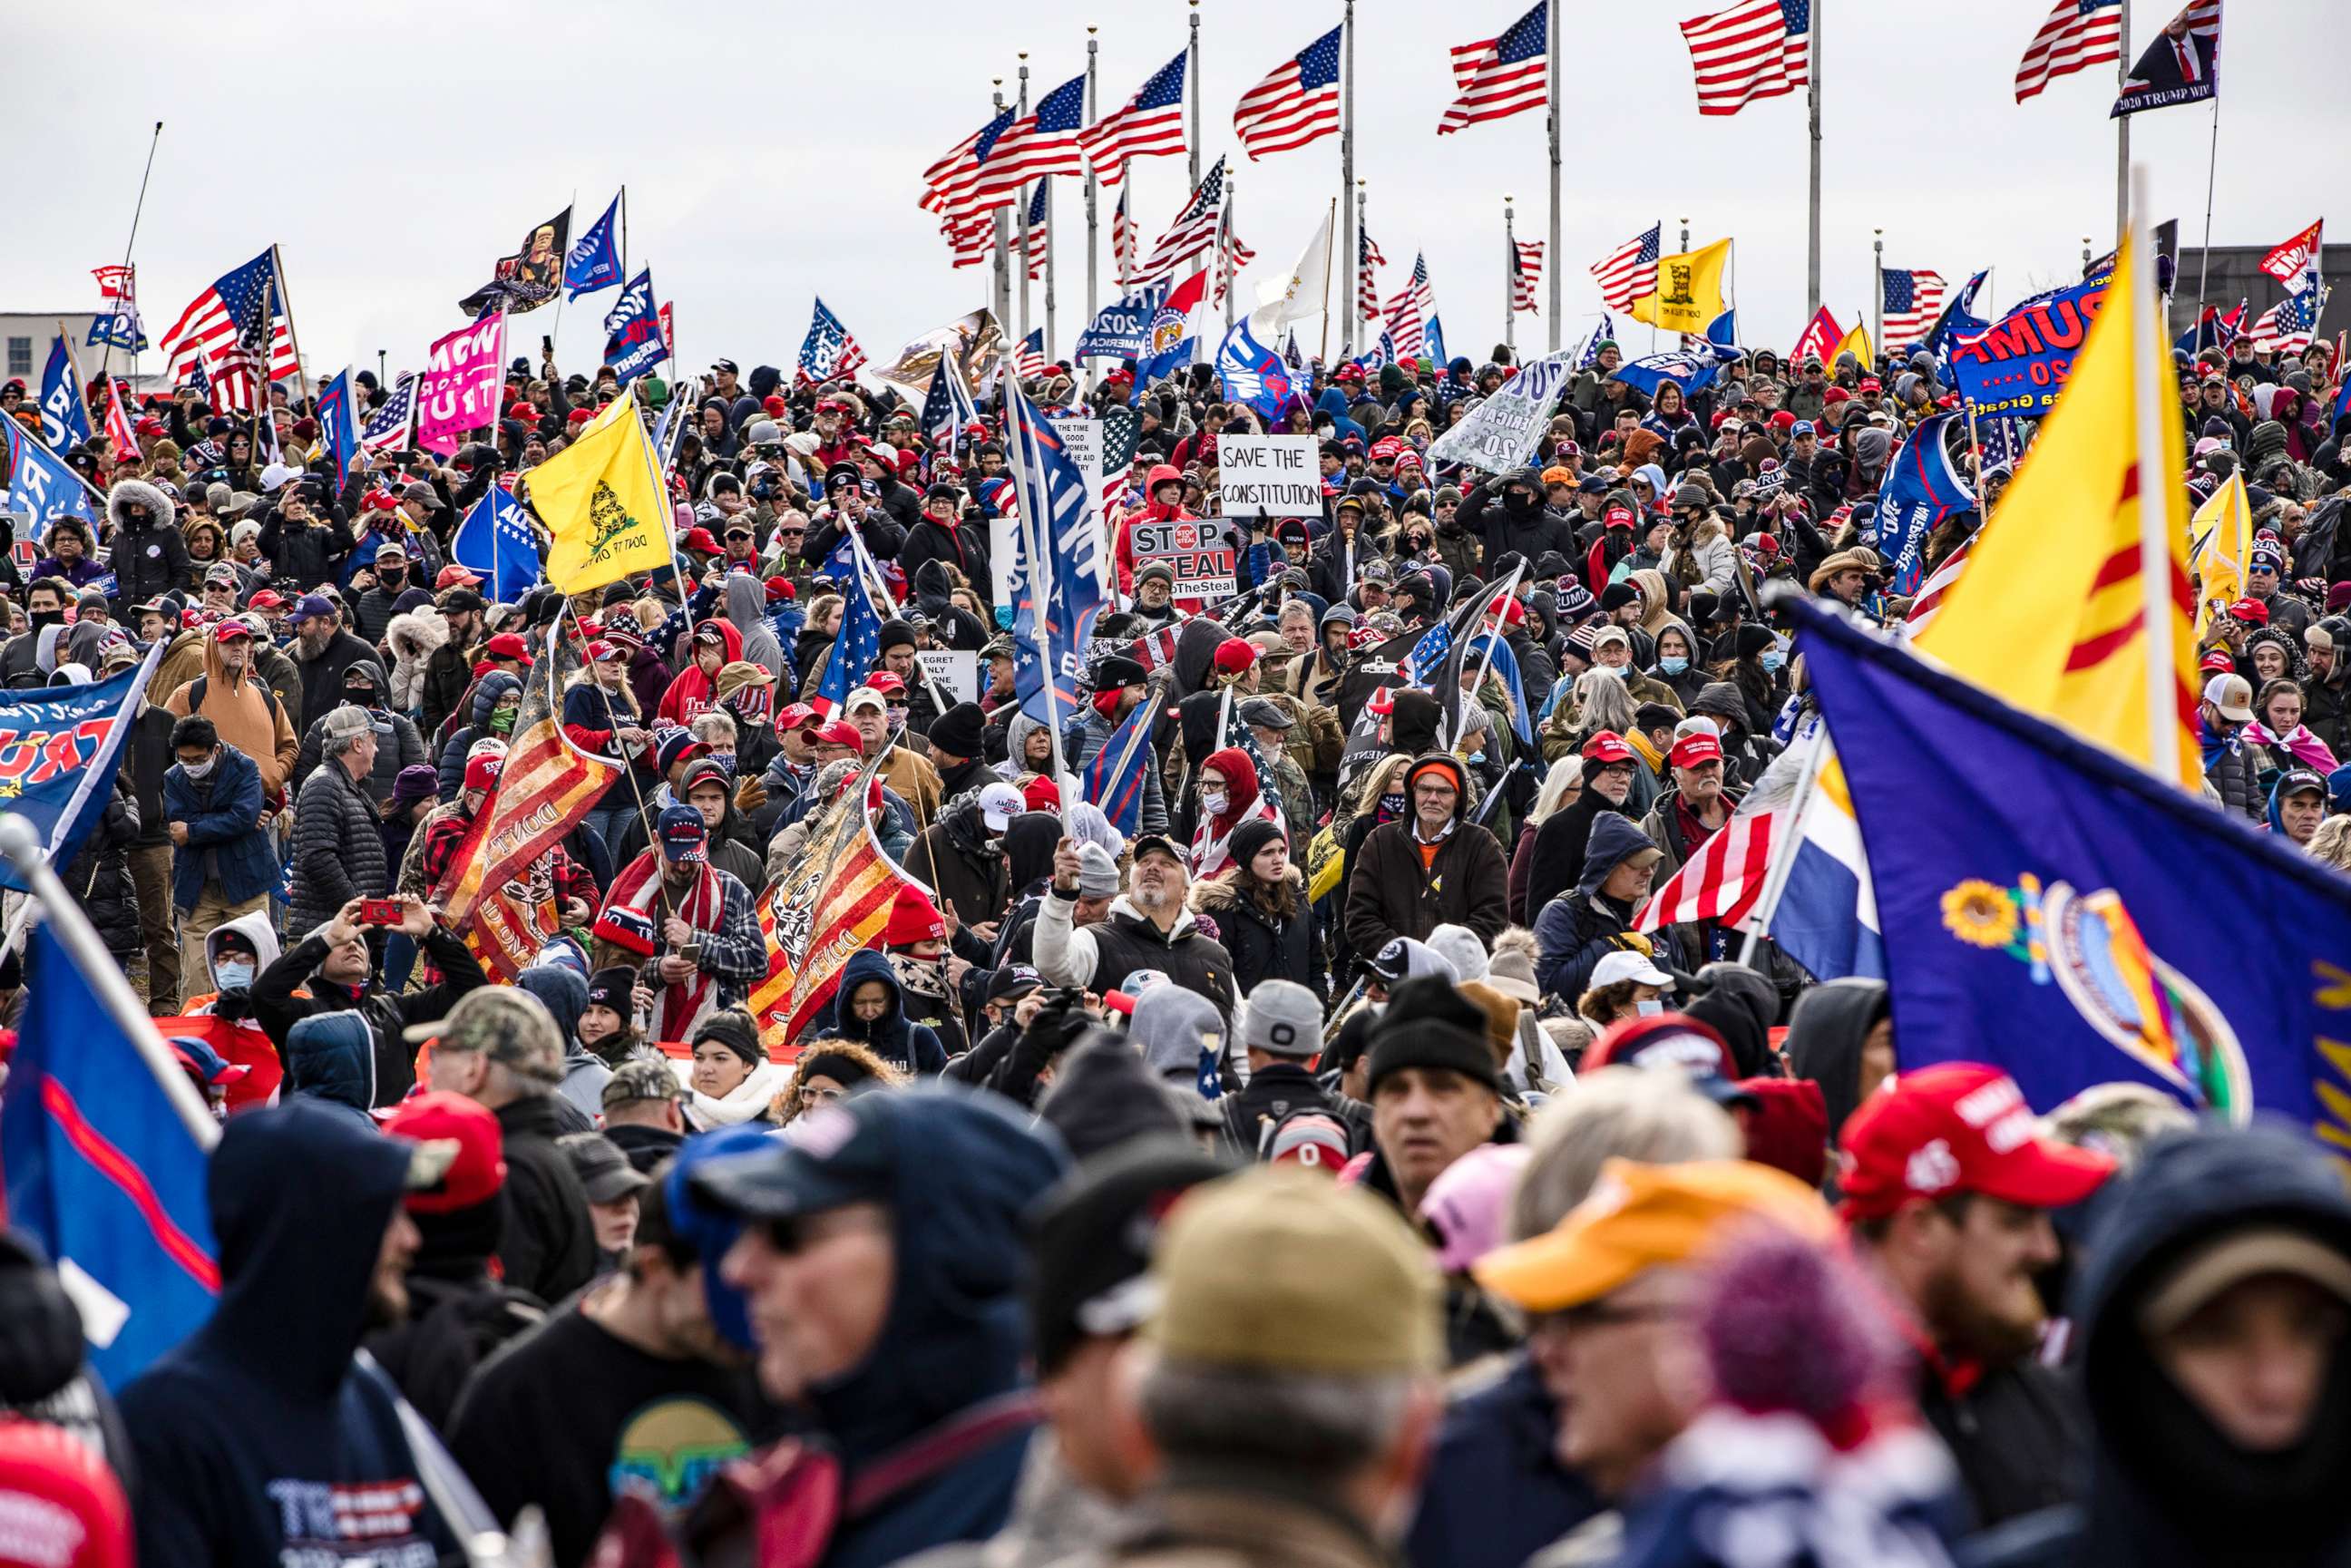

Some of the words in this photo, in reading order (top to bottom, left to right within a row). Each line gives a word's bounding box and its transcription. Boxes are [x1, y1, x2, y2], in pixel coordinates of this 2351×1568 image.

[2118, 96, 2142, 112] 2020
[2143, 89, 2188, 106] TRUMP
[1058, 424, 1071, 433] THE
[1072, 424, 1089, 433] TIME
[1065, 433, 1085, 443] GOOD
[1074, 453, 1082, 463] HE
[1083, 453, 1096, 463] AID
[1224, 446, 1267, 468] SAVE
[1272, 448, 1306, 471] THE
[1223, 483, 1322, 506] CONSTITUTION
[1556, 588, 1587, 608] RUMP
[922, 655, 955, 665] EGRET
[928, 666, 946, 675] NLY
[474, 737, 502, 751] TRUMP
[995, 799, 1024, 813] AMERICA
